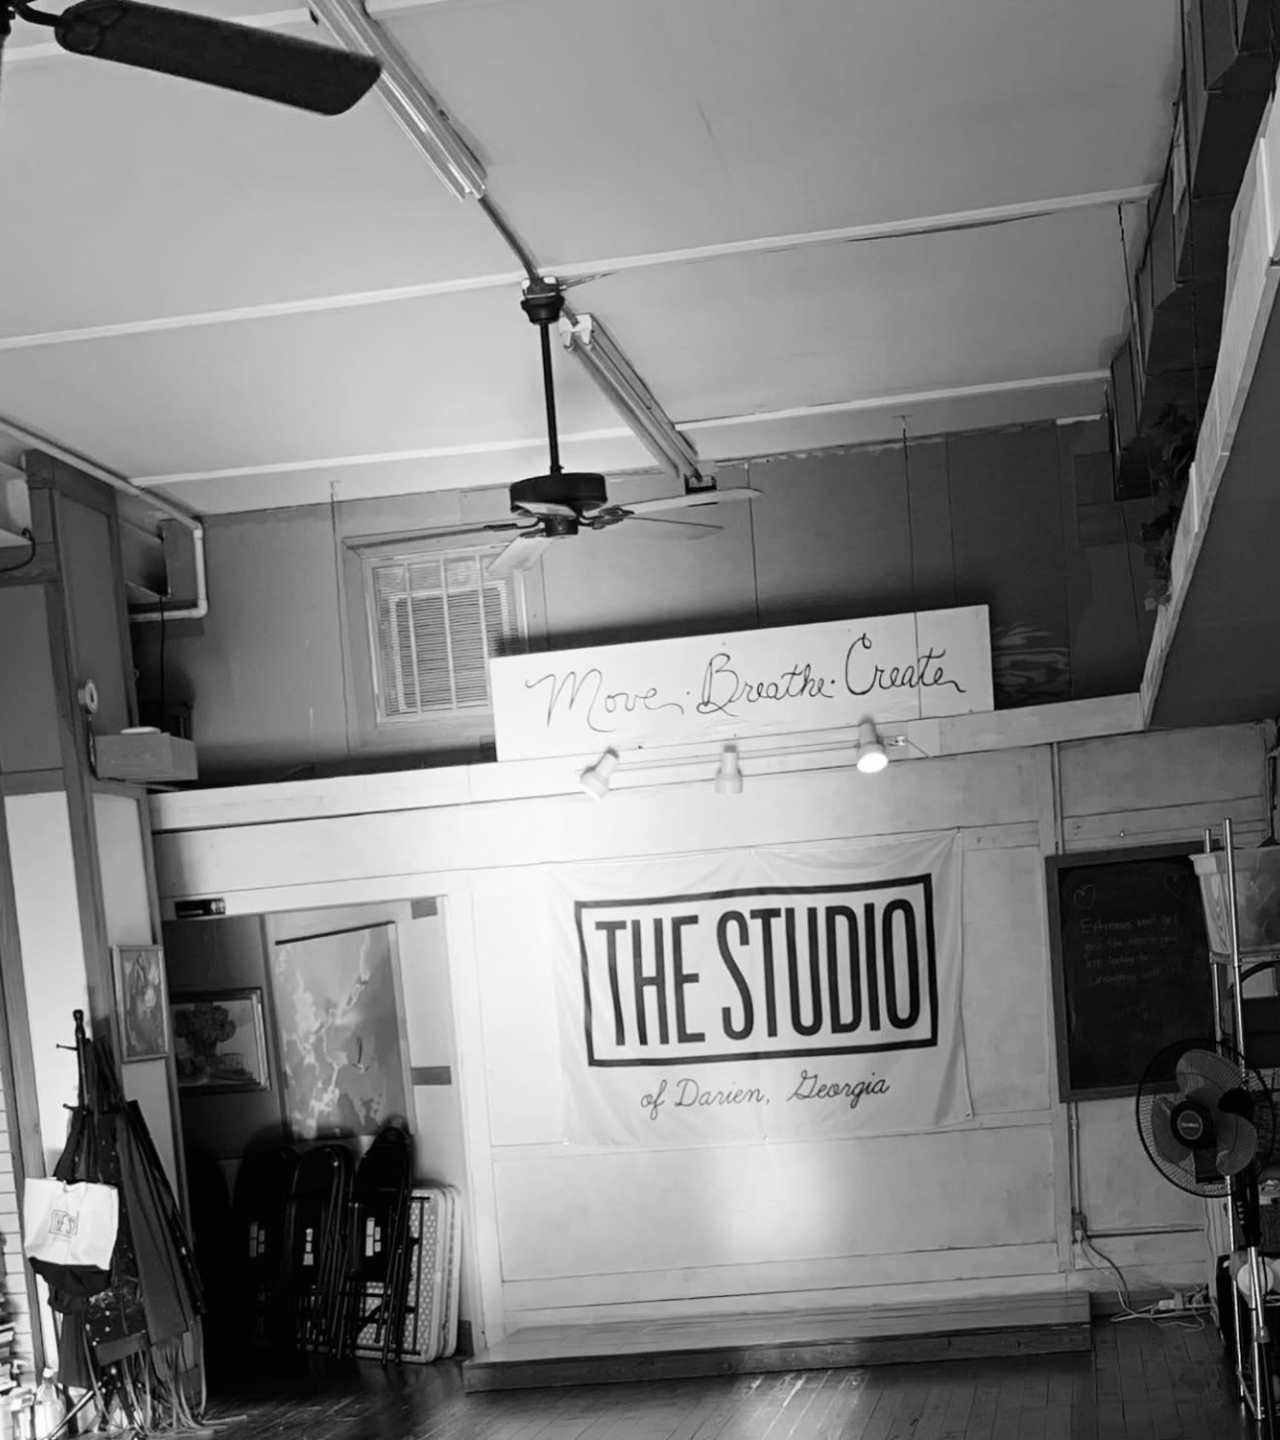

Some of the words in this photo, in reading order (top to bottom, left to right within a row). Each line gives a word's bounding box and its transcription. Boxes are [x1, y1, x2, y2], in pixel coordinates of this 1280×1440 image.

[525, 667, 685, 733] Move
[695, 653, 834, 717] Breathe
[845, 632, 967, 695] Create
[595, 914, 706, 1047] THE
[716, 898, 921, 1041] STUDIO
[640, 1079, 668, 1121] of
[786, 1070, 890, 1110] Georgia
